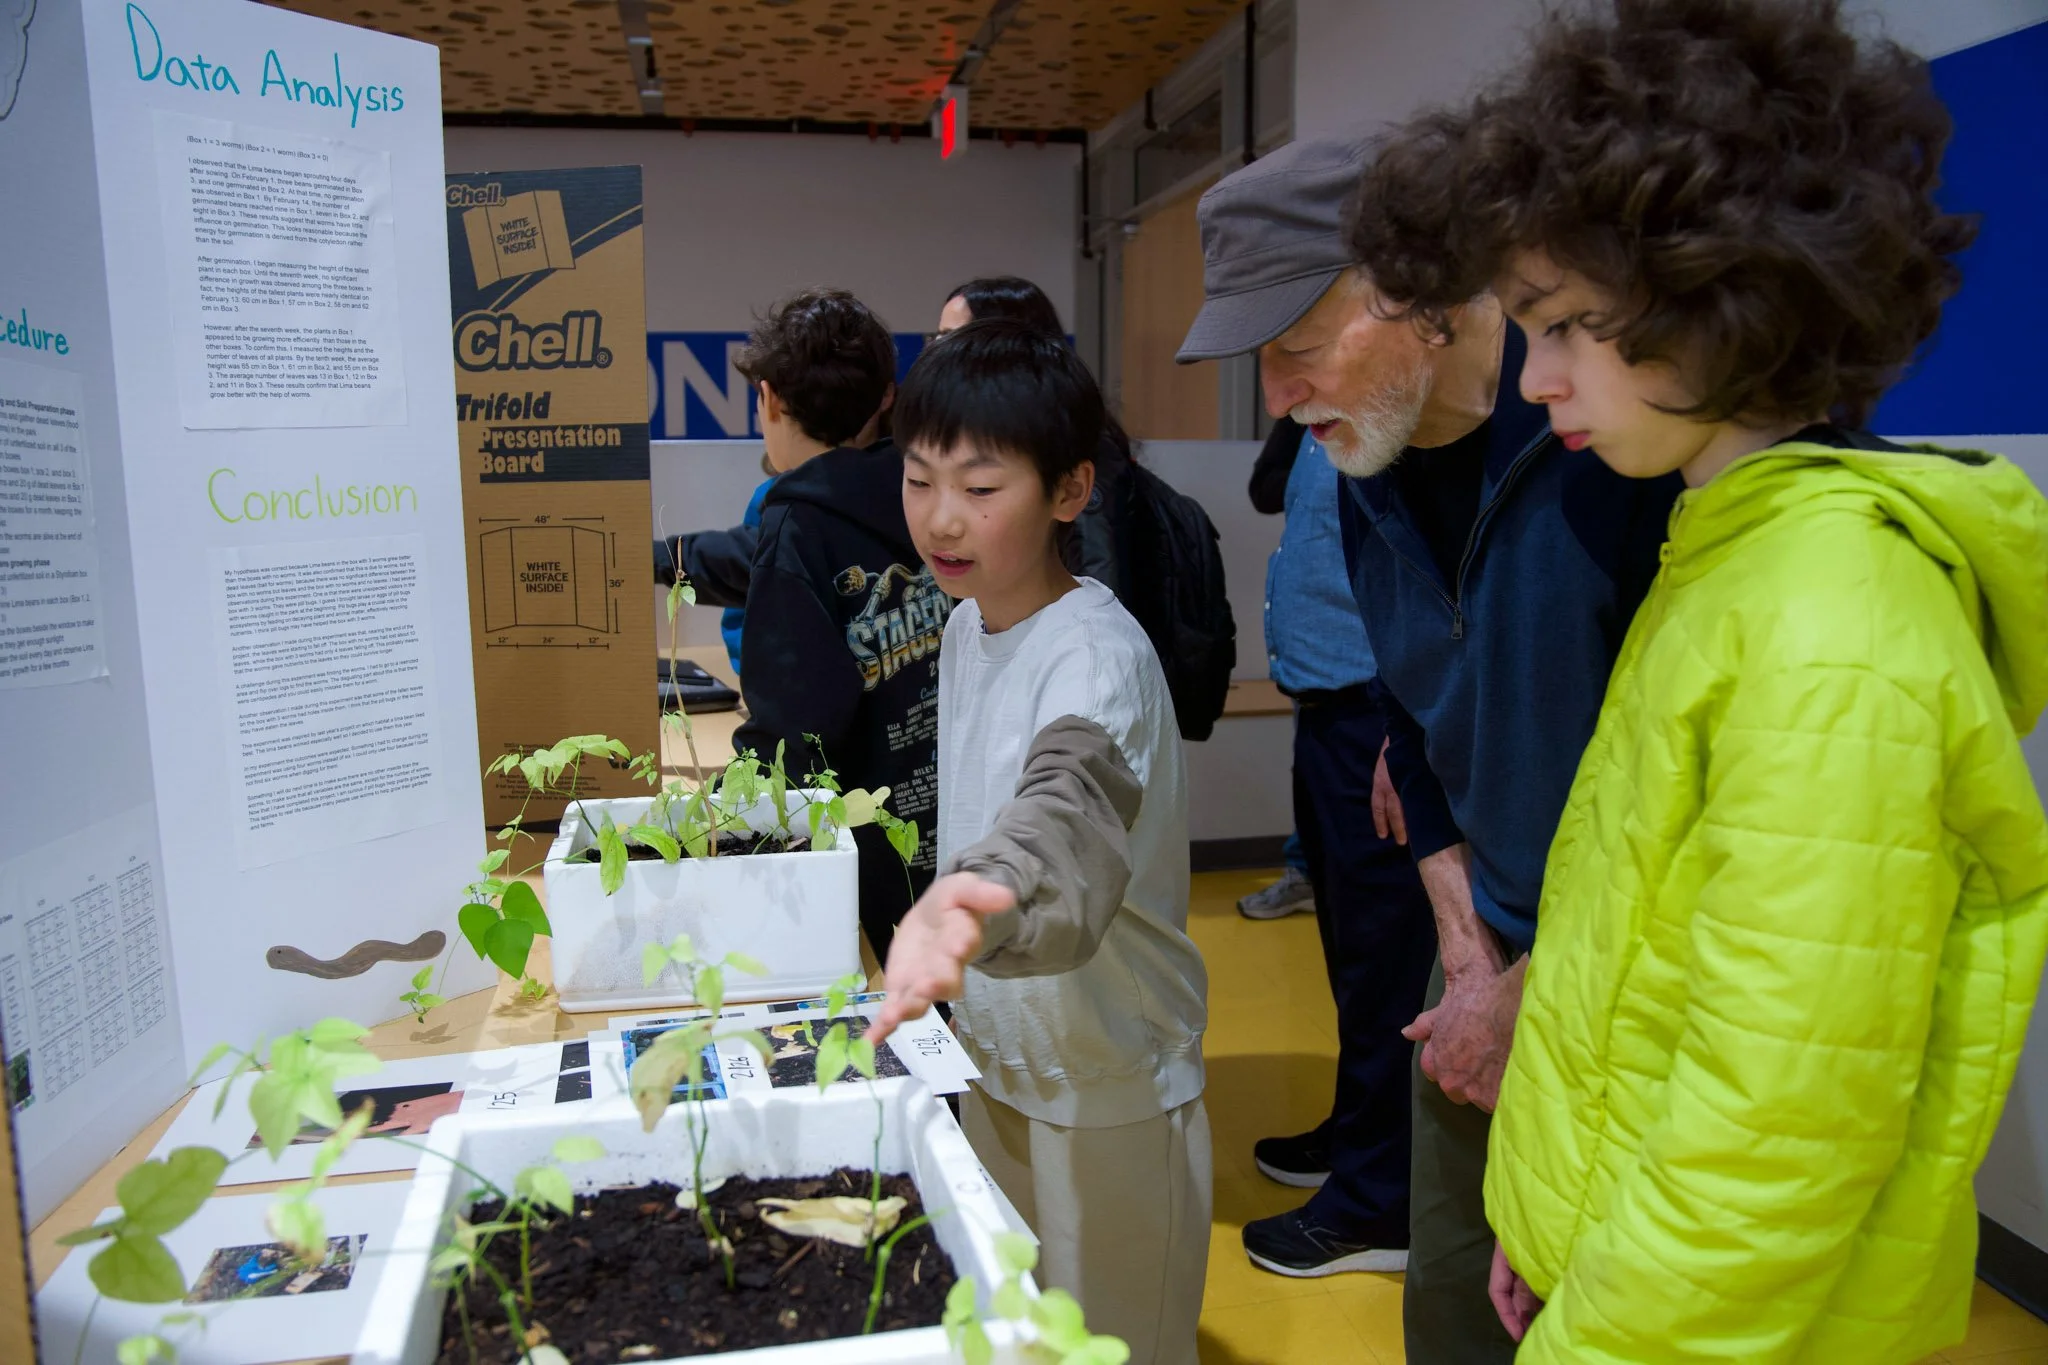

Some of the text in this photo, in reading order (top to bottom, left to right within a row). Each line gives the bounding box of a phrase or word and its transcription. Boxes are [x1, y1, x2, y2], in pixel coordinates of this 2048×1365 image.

[126, 2, 404, 128] Data Analysis
[446, 184, 500, 206] Chell
[501, 217, 530, 232] WHITE
[496, 227, 539, 245] SURFACE
[503, 241, 536, 255] INSIDE!
[456, 314, 600, 369] Chell
[456, 391, 551, 421] Trifold
[481, 425, 621, 449] Presentation
[480, 451, 544, 474] Board
[208, 468, 418, 523] Conclusion
[520, 573, 568, 582] SURFACE
[527, 562, 561, 571] WHITE
[526, 583, 564, 593] INSIDE!
[913, 765, 934, 777] RILEY
[728, 1056, 754, 1079] 2/26
